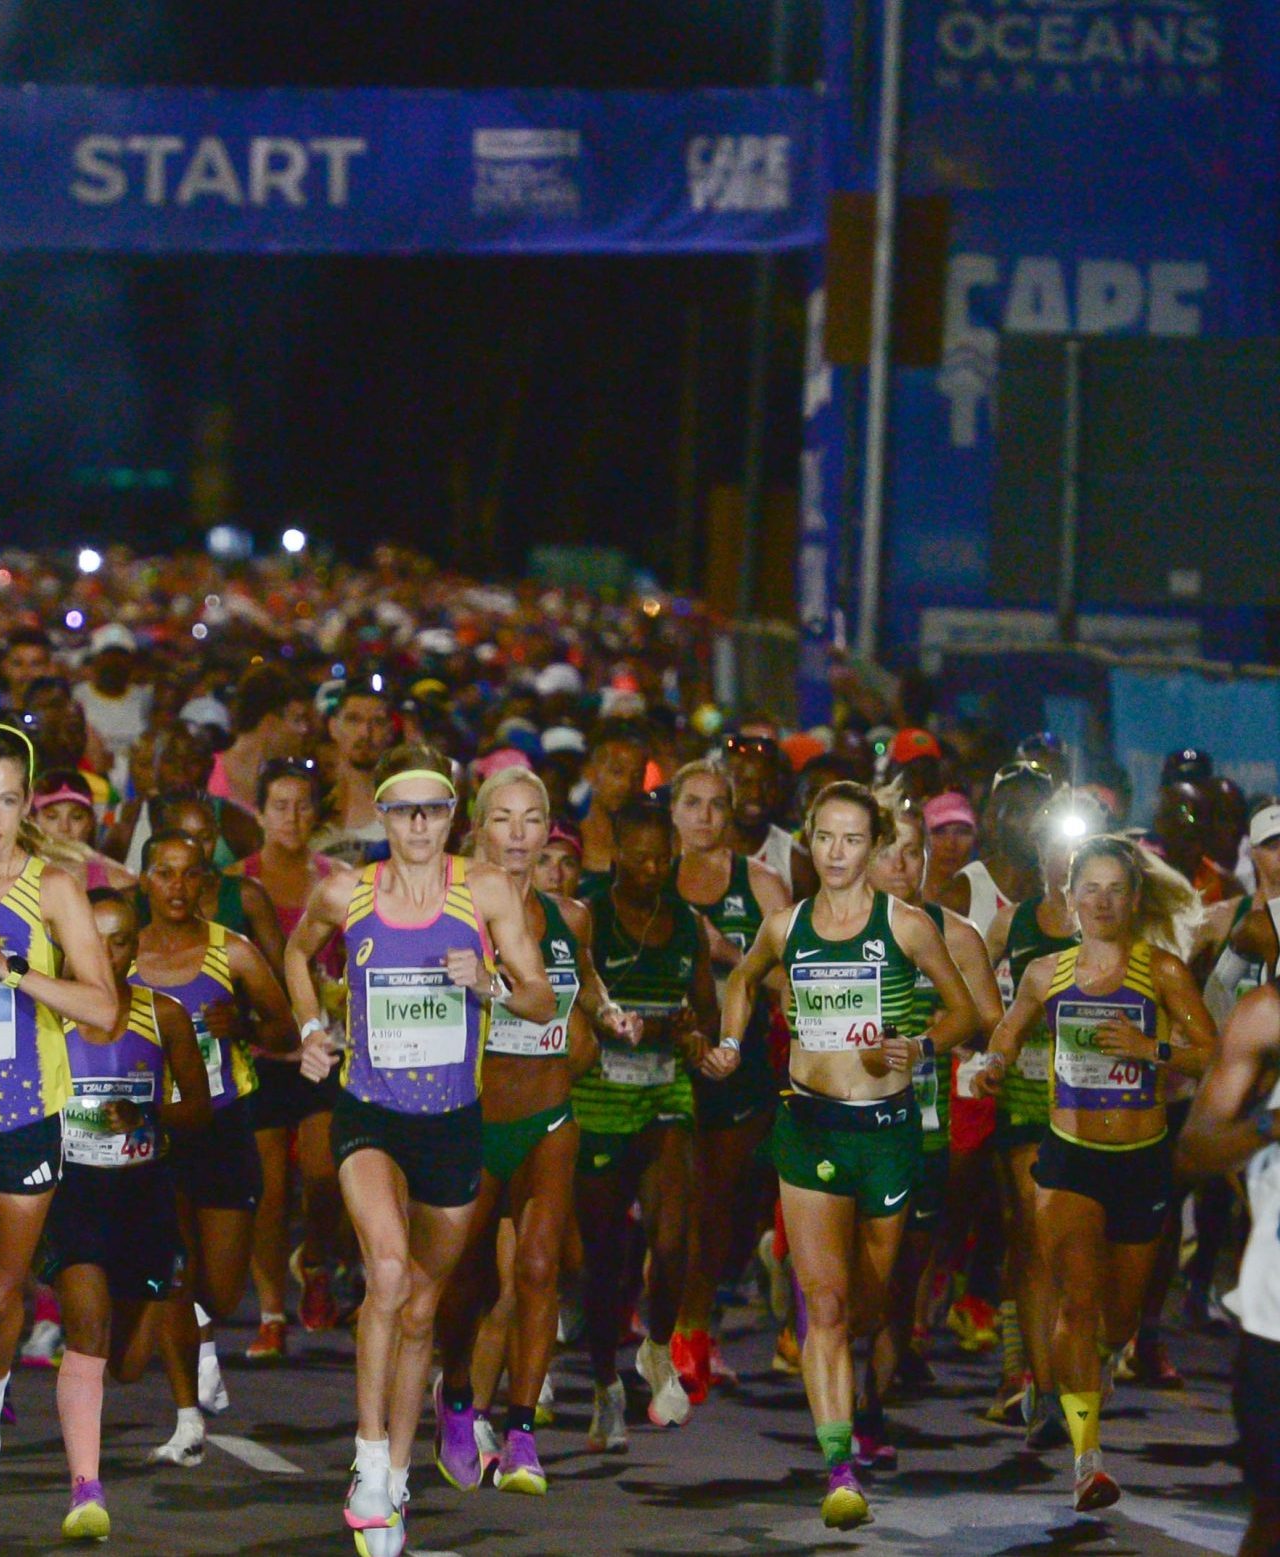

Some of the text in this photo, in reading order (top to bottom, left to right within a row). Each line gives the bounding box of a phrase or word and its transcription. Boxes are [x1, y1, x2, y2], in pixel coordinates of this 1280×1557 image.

[936, 13, 1219, 65] OCEANS
[70, 133, 367, 206] START
[385, 995, 448, 1020] Irvette
[540, 1025, 563, 1051] 40
[846, 1020, 879, 1048] 40
[1108, 1060, 1141, 1085] 40
[121, 1133, 151, 1159] 40
